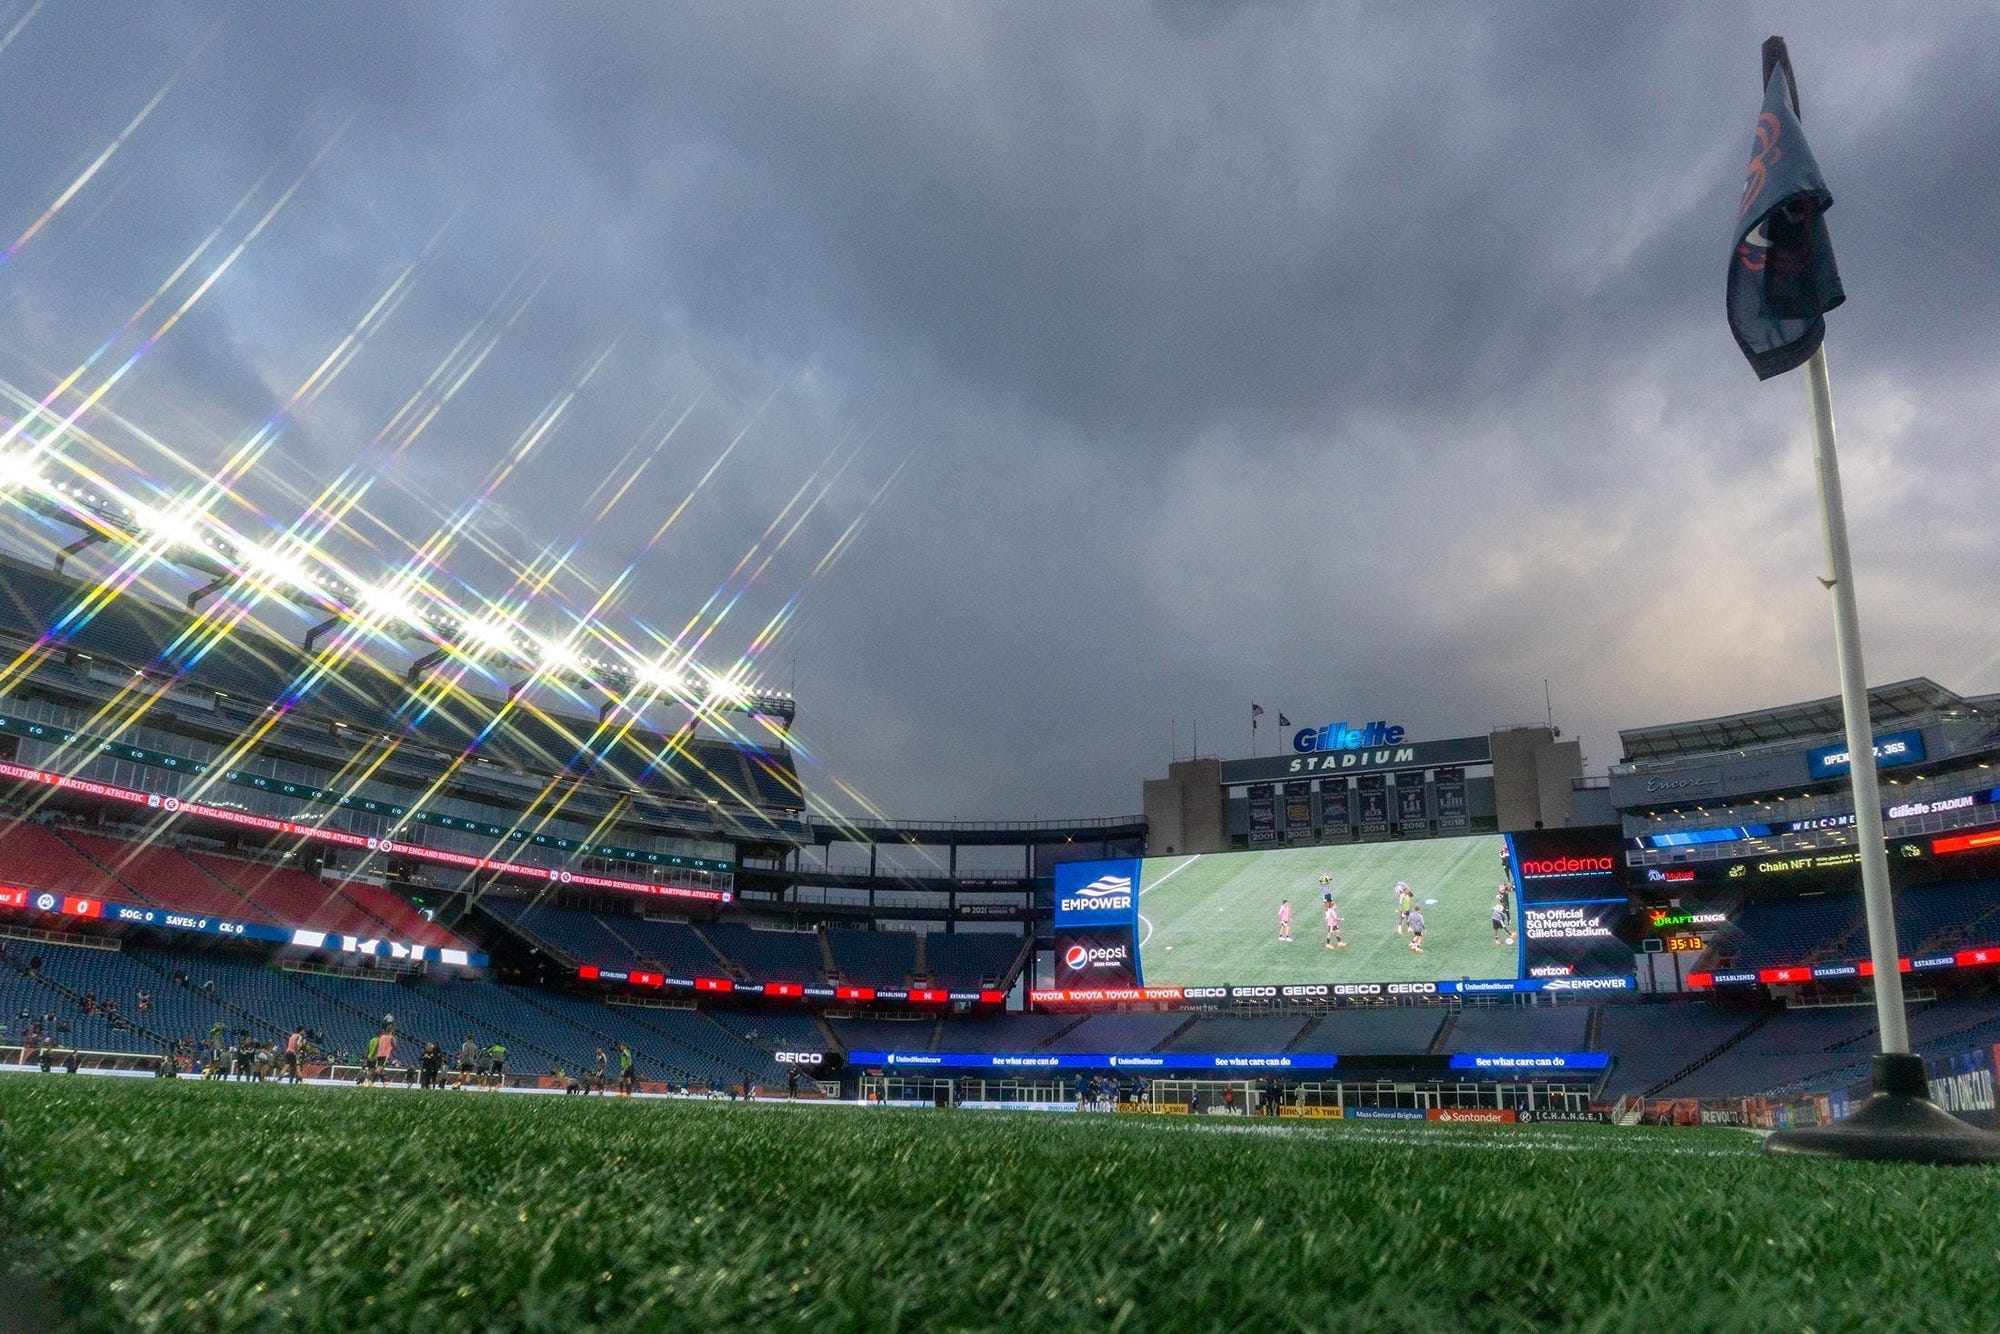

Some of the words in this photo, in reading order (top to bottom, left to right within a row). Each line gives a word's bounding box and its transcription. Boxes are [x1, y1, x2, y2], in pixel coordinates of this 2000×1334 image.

[1293, 721, 1405, 754] Gillette
[1289, 748, 1414, 772] STADIUM
[58, 777, 104, 794] HARTFORD
[105, 786, 144, 803] ATHLETIC
[1647, 775, 1716, 792] Encore
[1889, 803, 1929, 819] Gillette
[1931, 796, 1973, 813] STADIUM
[180, 803, 198, 813] NEW
[199, 805, 233, 820] ENGLAND
[234, 813, 280, 829] REVOLUTION
[294, 825, 331, 839] HARTFORD
[331, 831, 364, 845] ATHLETIC
[1441, 819, 1465, 827] 2018
[1793, 815, 1856, 830] WELCOME
[1252, 832, 1275, 840] 2001
[393, 845, 407, 854] NEW
[408, 848, 438, 859] ENGLAND
[438, 852, 477, 865] REVOLUTION
[488, 862, 520, 873] HARTFORD
[520, 866, 547, 877] ATHLETIC
[1523, 857, 1613, 874] moderna
[1759, 861, 1789, 872] Chain
[1791, 858, 1812, 870] NFT
[571, 875, 585, 883] NEW
[586, 878, 613, 887] ENGLAND
[613, 881, 649, 892] REVOLUTION
[660, 887, 692, 897] HARTFORD
[692, 890, 719, 900] ATHLETIC
[16, 893, 23, 904] 1
[1061, 896, 1132, 912] EMPOWER
[76, 901, 88, 914] 0
[1525, 911, 1546, 921] The
[1546, 908, 1584, 920] Official
[119, 908, 143, 920] SOG:
[145, 911, 154, 922] 0
[165, 915, 196, 928] SAVES:
[198, 919, 207, 930] 0
[219, 922, 234, 933] CK:
[235, 924, 244, 934] 0
[1526, 921, 1543, 930] 5G
[1543, 918, 1587, 929] Network
[1588, 917, 1600, 927] of
[1653, 912, 1727, 927] DRAFTKINGS
[1527, 928, 1564, 939] Gillette
[1564, 926, 1612, 938] Stadium.
[1670, 938, 1702, 950] 35:13
[1088, 945, 1127, 962] pepsi
[1530, 965, 1569, 977] verizon
[1715, 973, 1756, 982] ESTABLISHED
[1778, 971, 1789, 980] 96
[1814, 967, 1855, 977] ESTABLISHED
[1914, 957, 1954, 968] ESTABLISHED
[1975, 952, 1987, 962] 96
[600, 971, 628, 980] ESTABLISHED
[804, 988, 834, 996] ESTABLISHED
[877, 991, 908, 999] ESTABLISHED
[1031, 991, 1065, 1001] TOYOTA
[1069, 991, 1103, 1000] TOYOTA
[1105, 990, 1139, 999] TOYOTA
[1145, 989, 1180, 998] TOYOTA
[1184, 988, 1227, 998] GEICO
[1232, 987, 1276, 997] GEICO
[1282, 985, 1328, 996] GEICO
[1334, 984, 1381, 995] GEICO
[1387, 983, 1436, 994] GEICO
[1465, 983, 1514, 991] UnitedHealthcare
[1571, 979, 1626, 989] EMPOWER
[775, 1052, 823, 1064] GEICO
[896, 1056, 941, 1064] UnitedHealthcare
[992, 1057, 1005, 1065] See
[1005, 1057, 1022, 1065] what
[1118, 1057, 1163, 1065] UnitedHealthcare
[1215, 1058, 1229, 1066] See
[1476, 1058, 1491, 1066] See
[1397, 1112, 1424, 1120] Brigham
[1452, 1112, 1503, 1122] Santander
